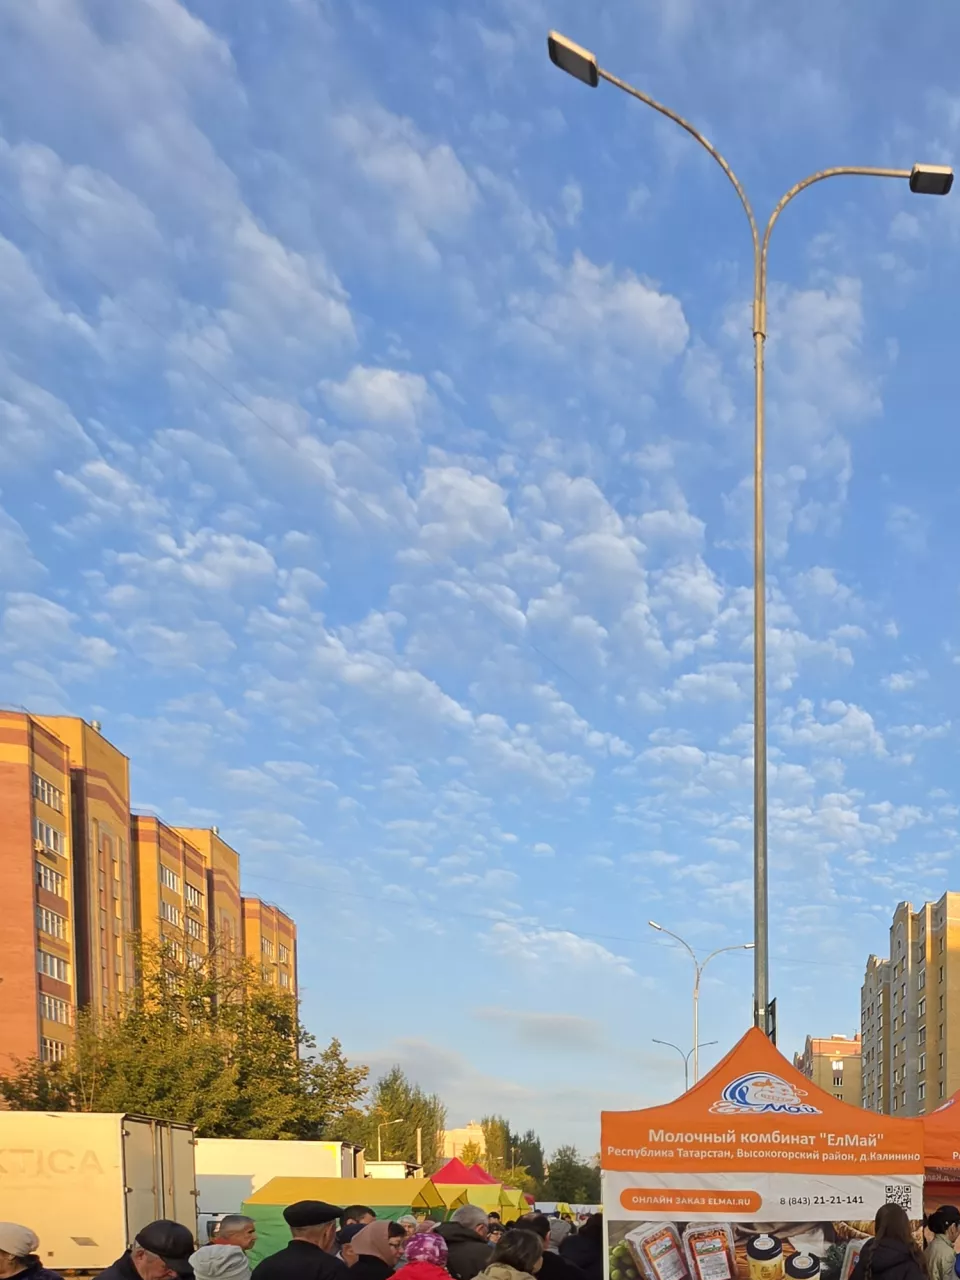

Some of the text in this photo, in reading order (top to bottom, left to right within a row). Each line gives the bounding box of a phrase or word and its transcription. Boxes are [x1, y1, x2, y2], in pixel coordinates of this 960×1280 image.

[649, 1129, 884, 1147] Молочный комбинат "ЕлМай"
[607, 1146, 921, 1162] Республика Татарстан, Высокогорский район, д.Калинино
[632, 1195, 751, 1206] ОНЛАЙН ЗАКАЗ ELMAI.RU
[780, 1196, 864, 1206] 8 (843) 21-21-141
